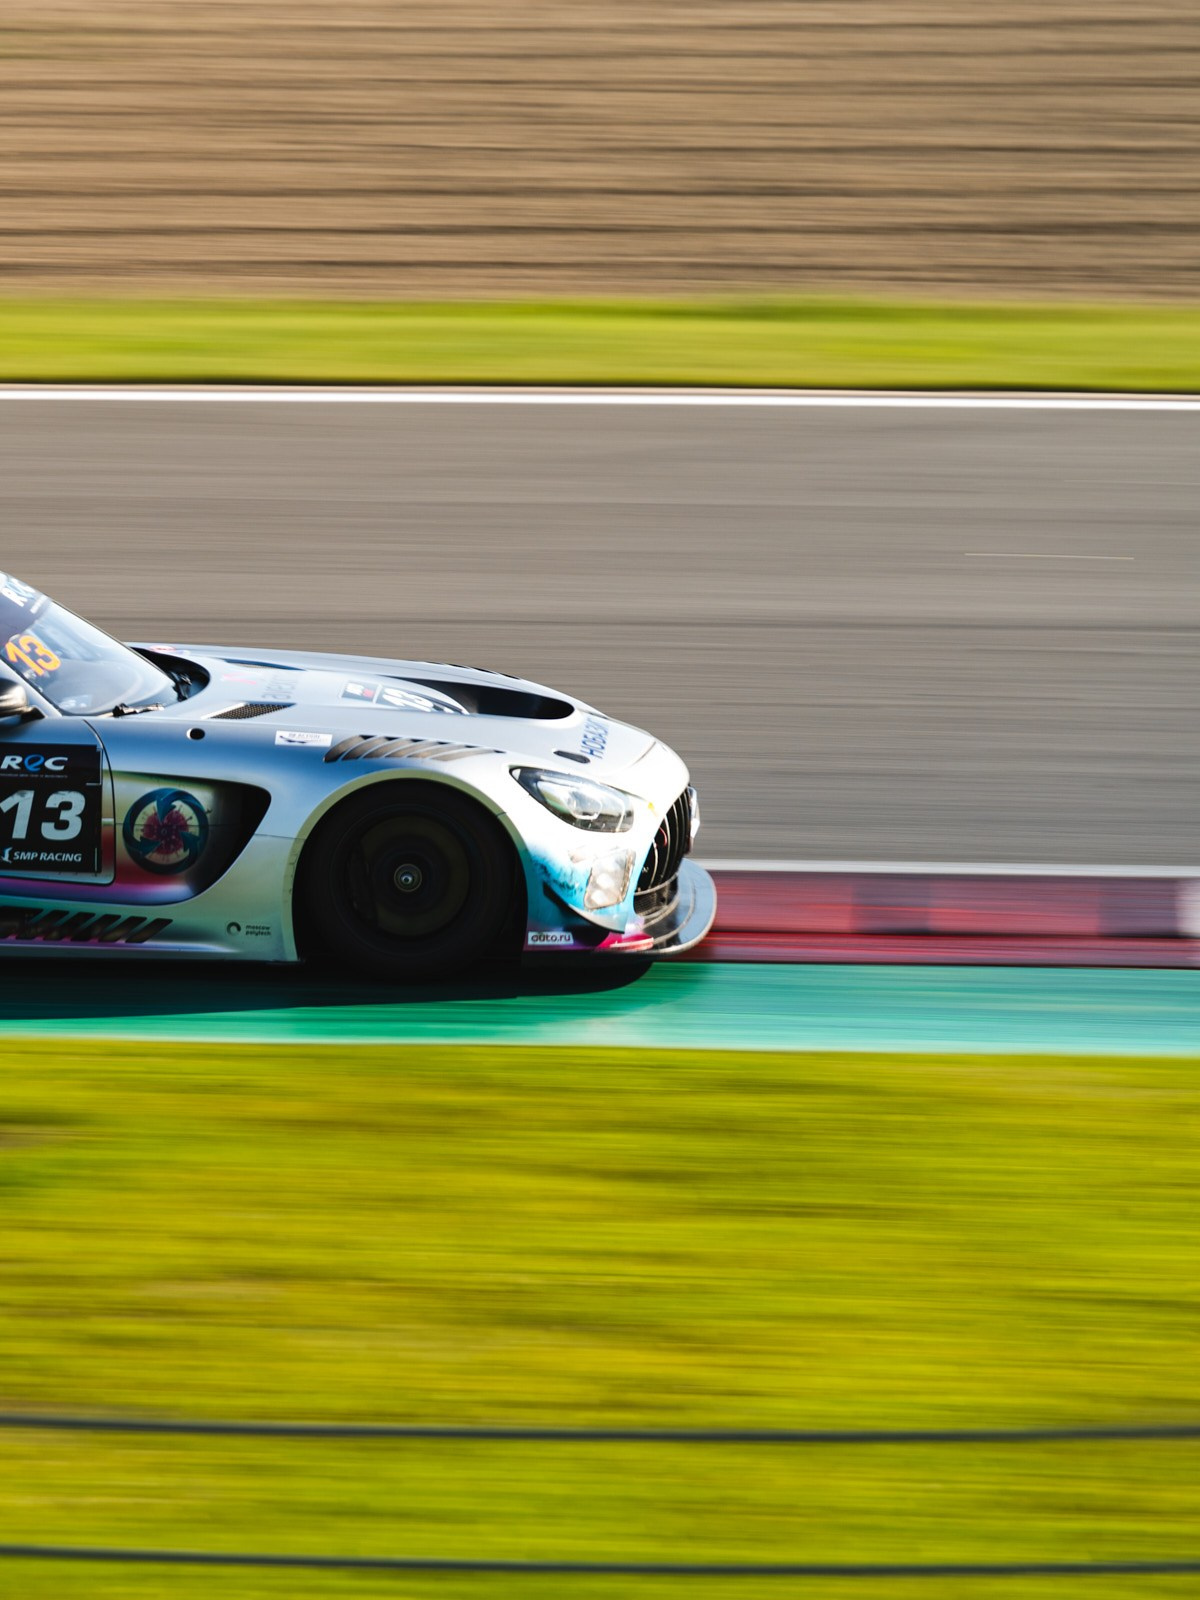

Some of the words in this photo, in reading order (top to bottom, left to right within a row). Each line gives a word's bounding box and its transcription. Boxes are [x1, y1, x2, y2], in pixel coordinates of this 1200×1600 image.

[4, 635, 61, 687] 13
[13, 851, 39, 861] SMP
[39, 852, 82, 862] RACING
[531, 933, 571, 943] auto.ru
